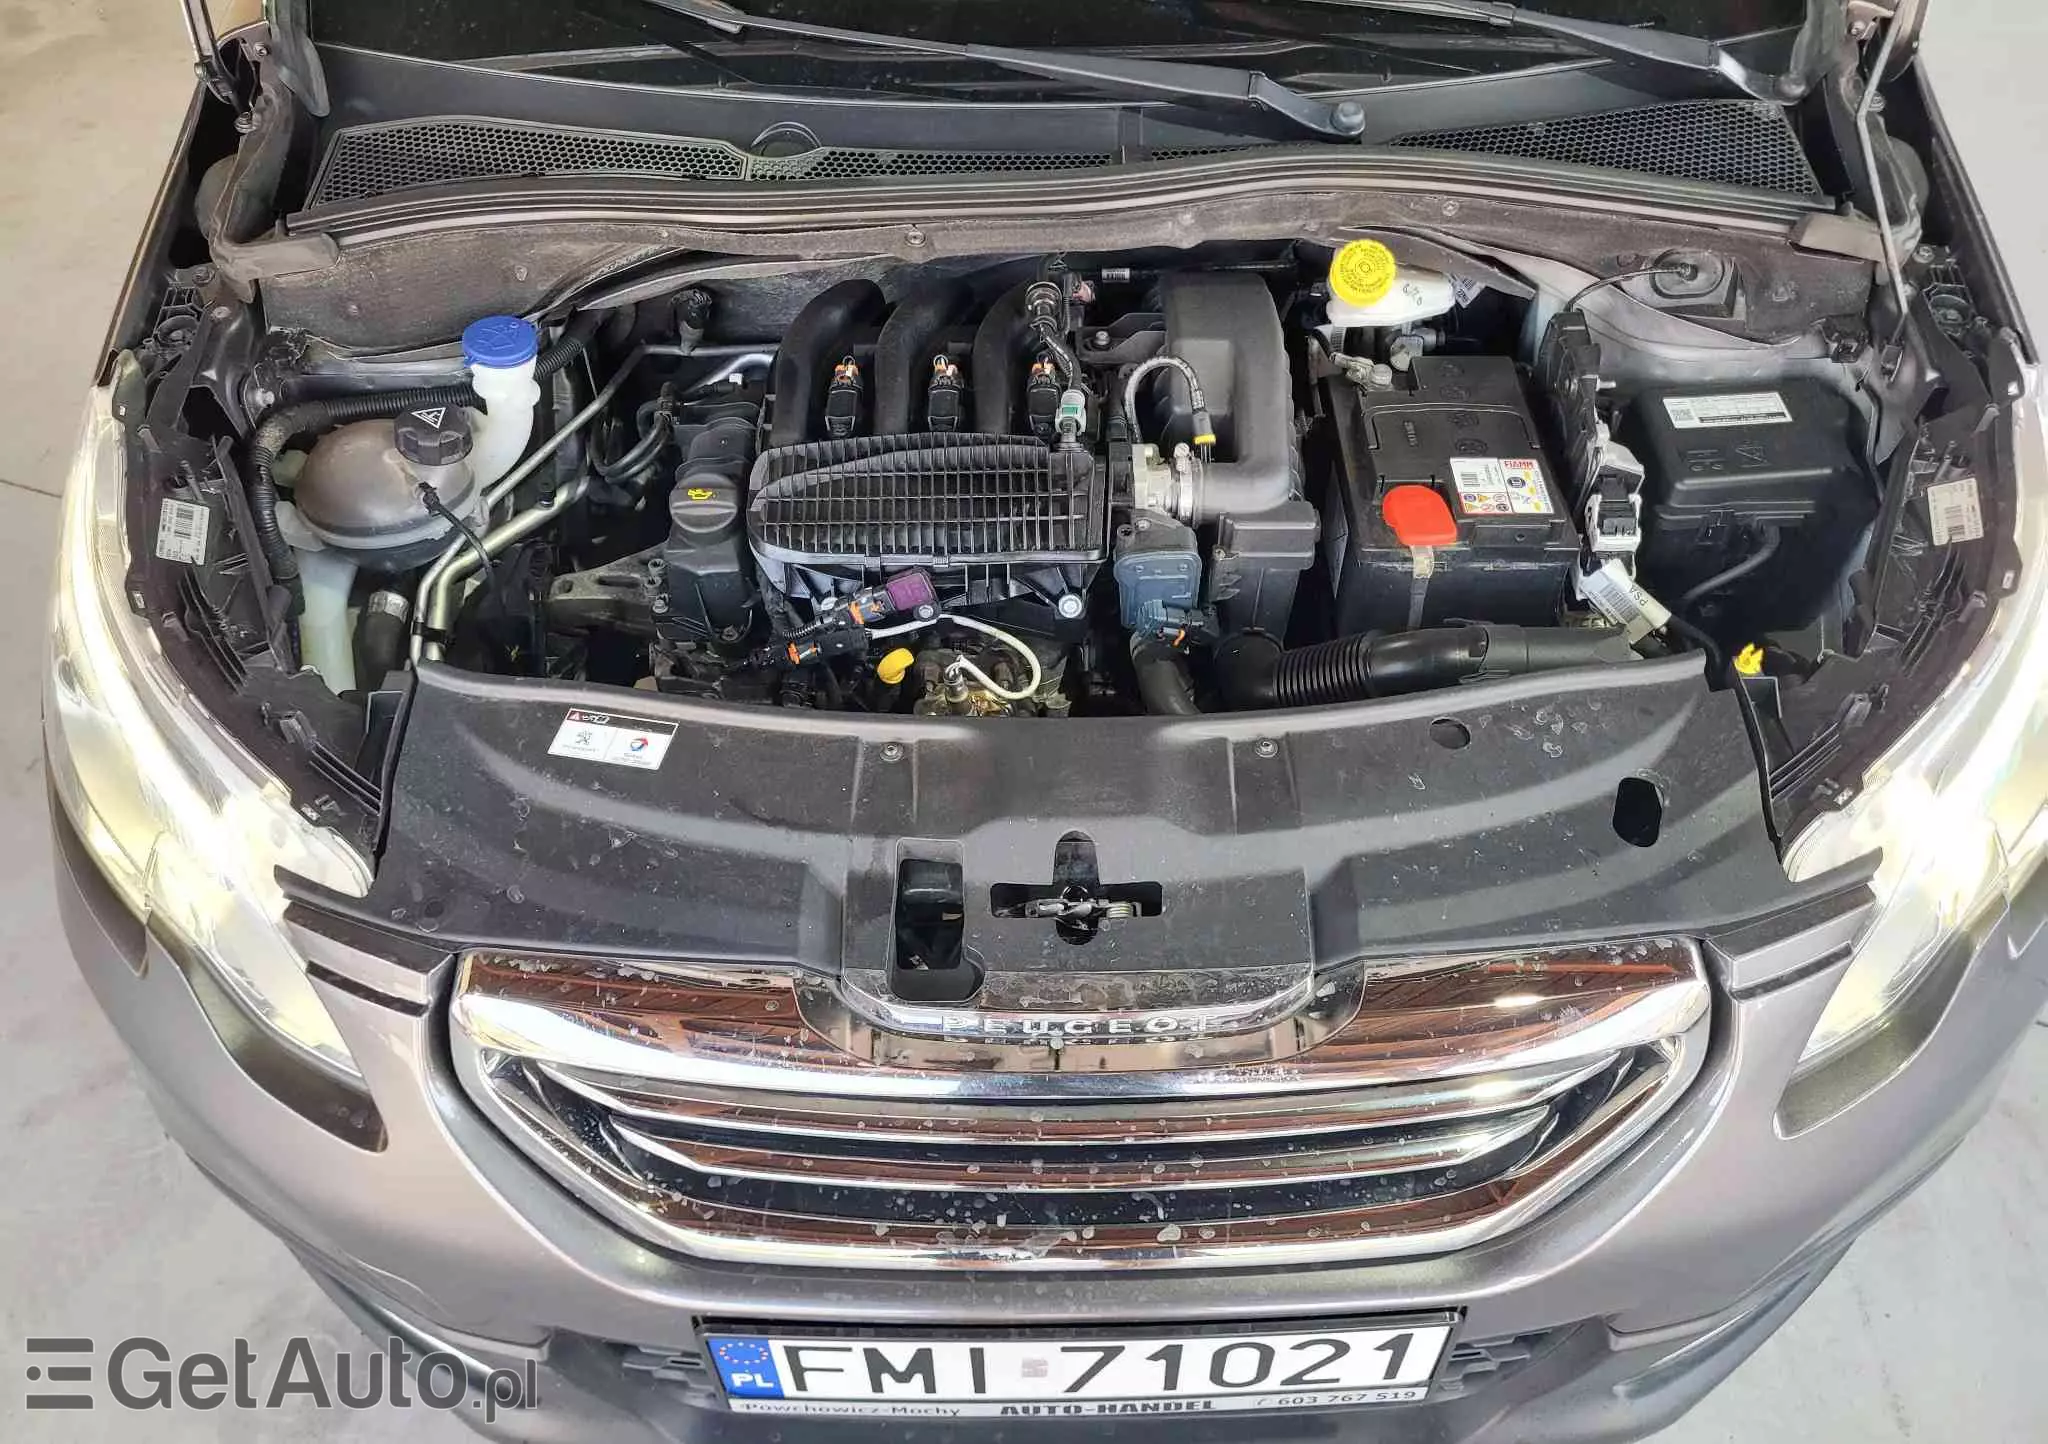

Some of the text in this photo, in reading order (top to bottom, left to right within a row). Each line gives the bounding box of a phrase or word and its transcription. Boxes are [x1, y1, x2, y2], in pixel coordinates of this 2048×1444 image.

[942, 1014, 1214, 1034] PEUGEOT
[783, 1332, 1415, 1393] FMI 71021
[731, 1373, 774, 1389] PL
[1000, 1400, 1217, 1415] AUTO-HANDEL
[1277, 1395, 1318, 1406] 603
[1328, 1393, 1368, 1404] 767
[1375, 1390, 1417, 1401] 519
